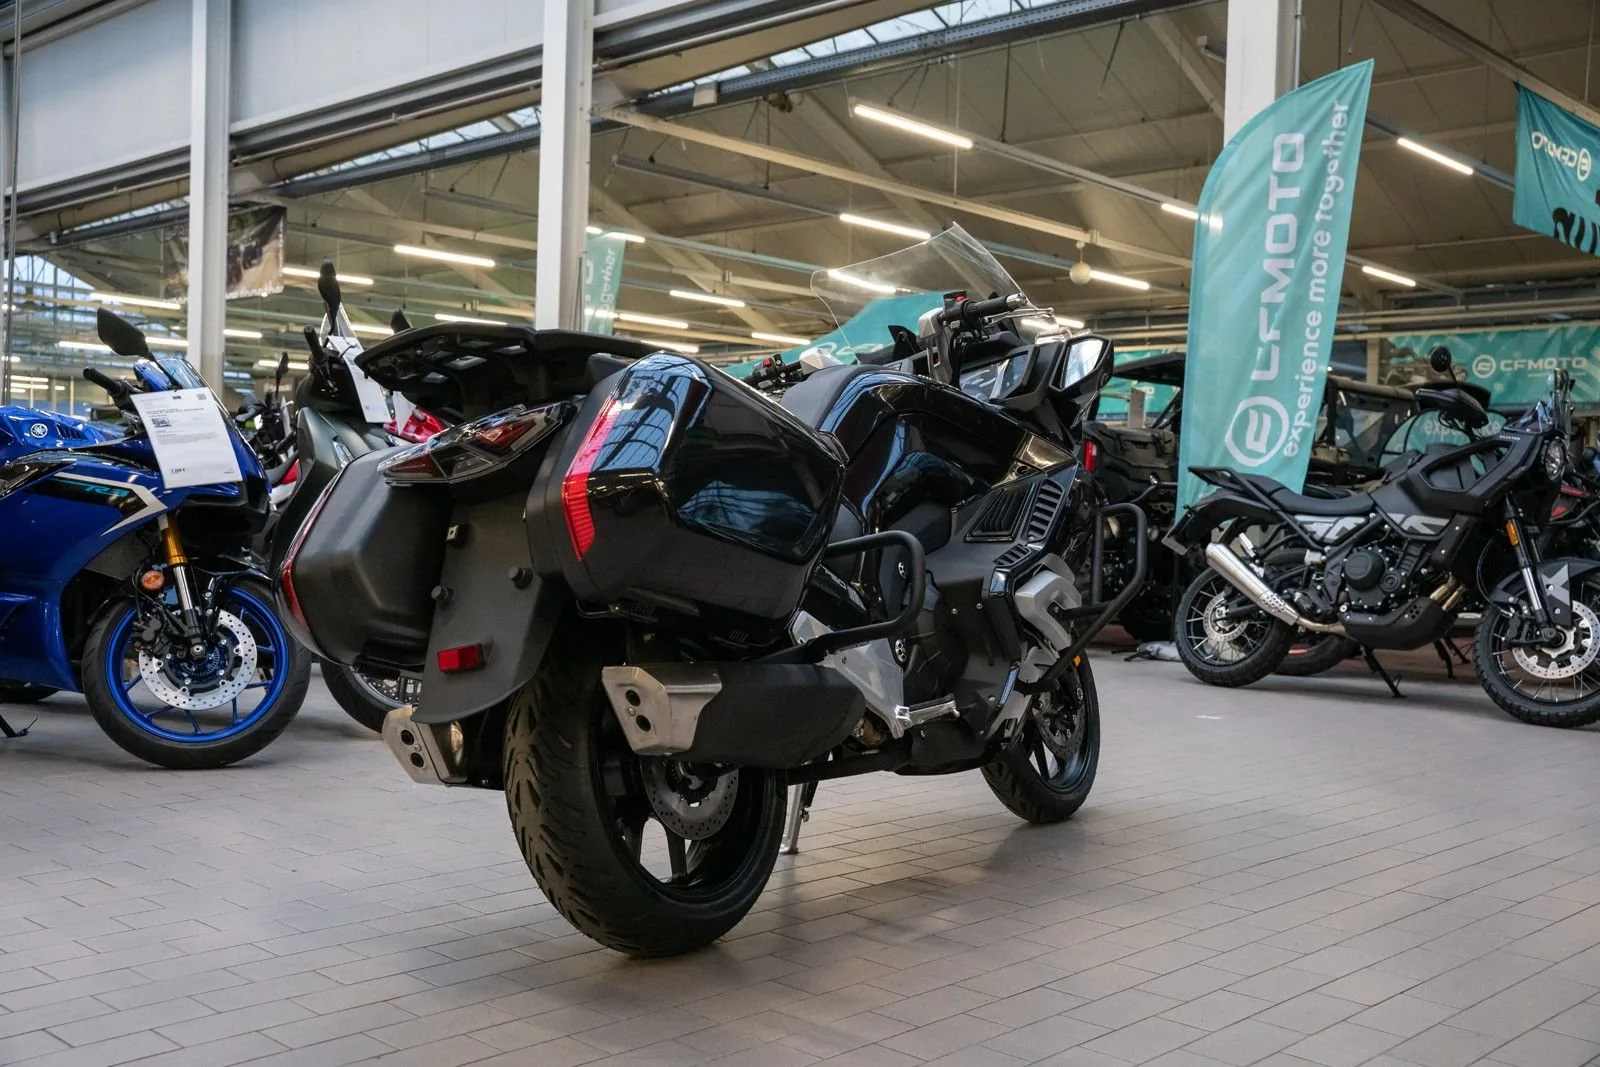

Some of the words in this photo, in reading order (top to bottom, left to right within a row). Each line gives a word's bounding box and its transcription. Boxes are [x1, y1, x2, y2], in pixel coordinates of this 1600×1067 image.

[1314, 99, 1349, 222] together
[1250, 132, 1305, 381] CFMOTO
[1309, 229, 1332, 303] more
[1283, 310, 1322, 457] experience
[1500, 356, 1587, 371] CFMOTO
